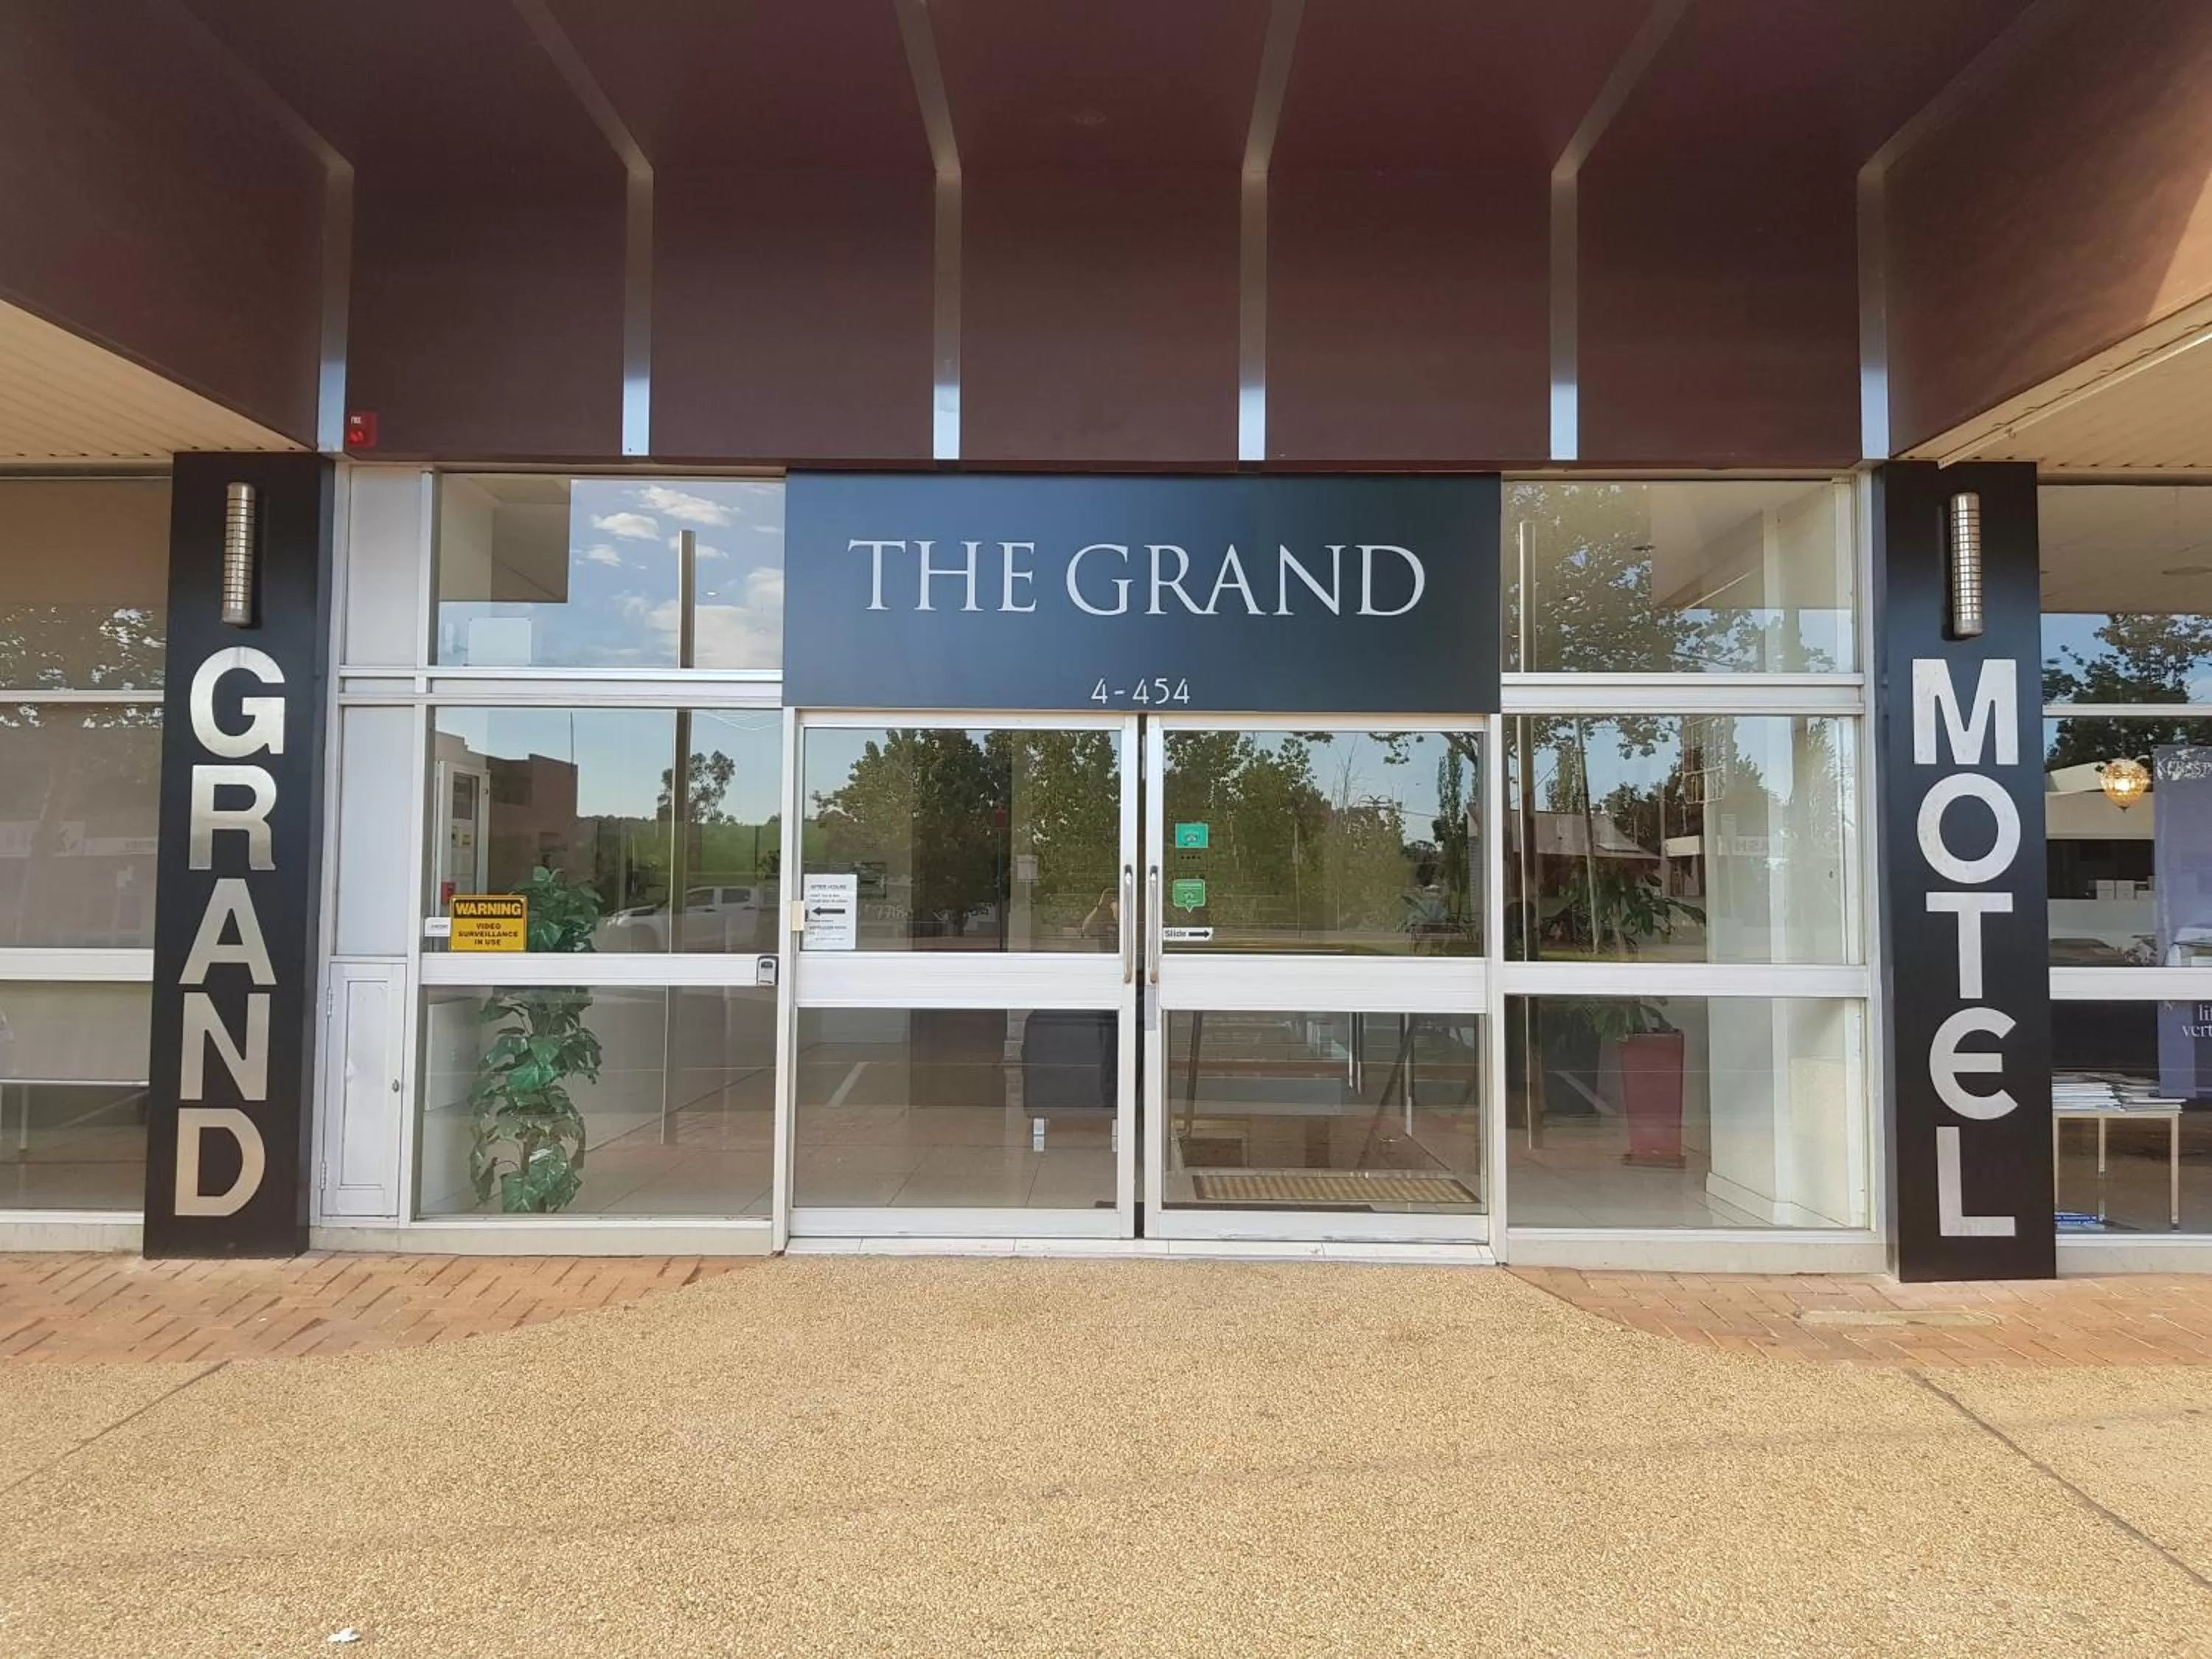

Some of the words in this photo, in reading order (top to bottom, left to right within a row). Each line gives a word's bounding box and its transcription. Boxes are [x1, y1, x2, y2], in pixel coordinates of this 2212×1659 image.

[847, 539, 1037, 613] THE
[1065, 543, 1426, 618] GRAND
[1091, 678, 1191, 704] 4-454
[174, 646, 286, 1217] GRAND
[455, 902, 521, 915] WARNING
[1164, 930, 1186, 938] Slide
[1912, 658, 2020, 1238] MOTEL
